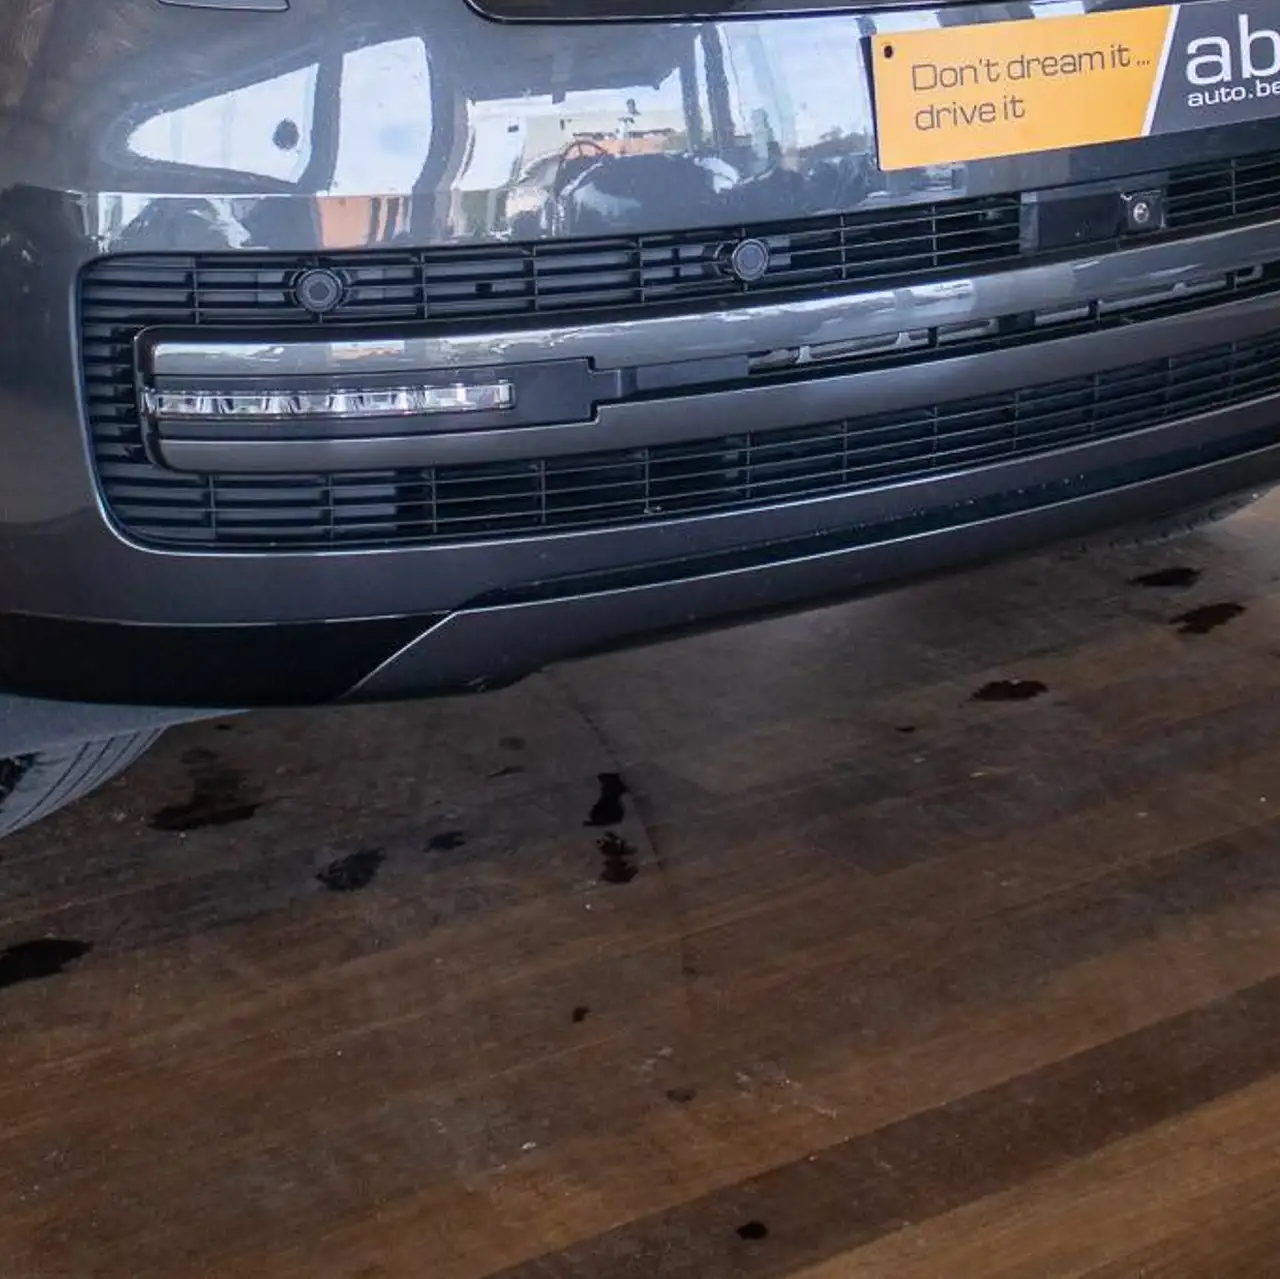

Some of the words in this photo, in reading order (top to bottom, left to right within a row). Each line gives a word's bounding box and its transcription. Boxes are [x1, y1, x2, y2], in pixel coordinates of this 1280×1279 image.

[911, 57, 1000, 91] Don't
[1007, 48, 1105, 81] dream
[915, 102, 997, 132] drive
[1003, 95, 1026, 121] it
